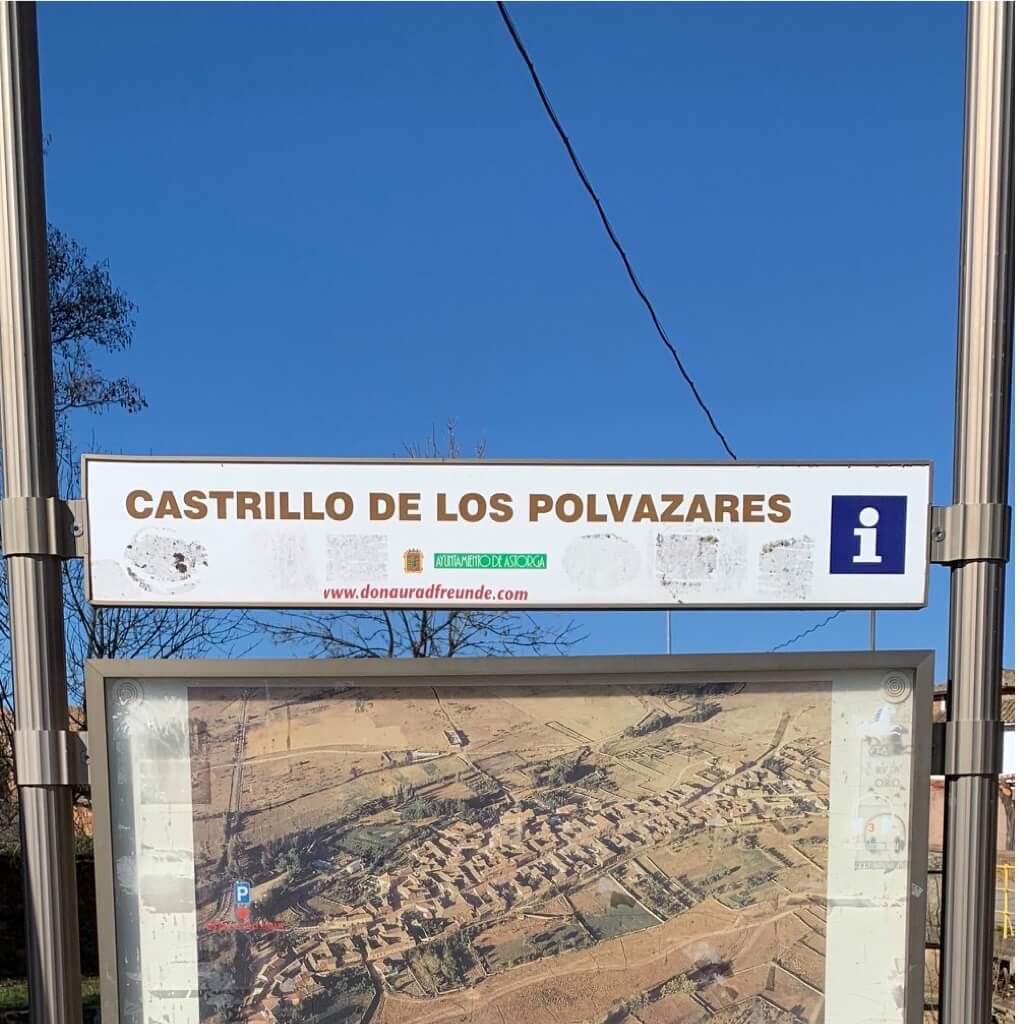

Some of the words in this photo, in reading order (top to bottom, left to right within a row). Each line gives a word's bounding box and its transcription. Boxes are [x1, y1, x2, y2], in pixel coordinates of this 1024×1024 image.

[126, 490, 354, 521] CASTRILLO
[369, 492, 421, 521] DE
[437, 493, 515, 522] LOS
[529, 493, 792, 523] POLVAZARES
[436, 554, 490, 568] AYUNTAMIENTO
[491, 554, 503, 568] DE
[503, 554, 545, 568] ASTORGA
[323, 584, 529, 602] www.donauradfreunde.com
[236, 886, 249, 902] P
